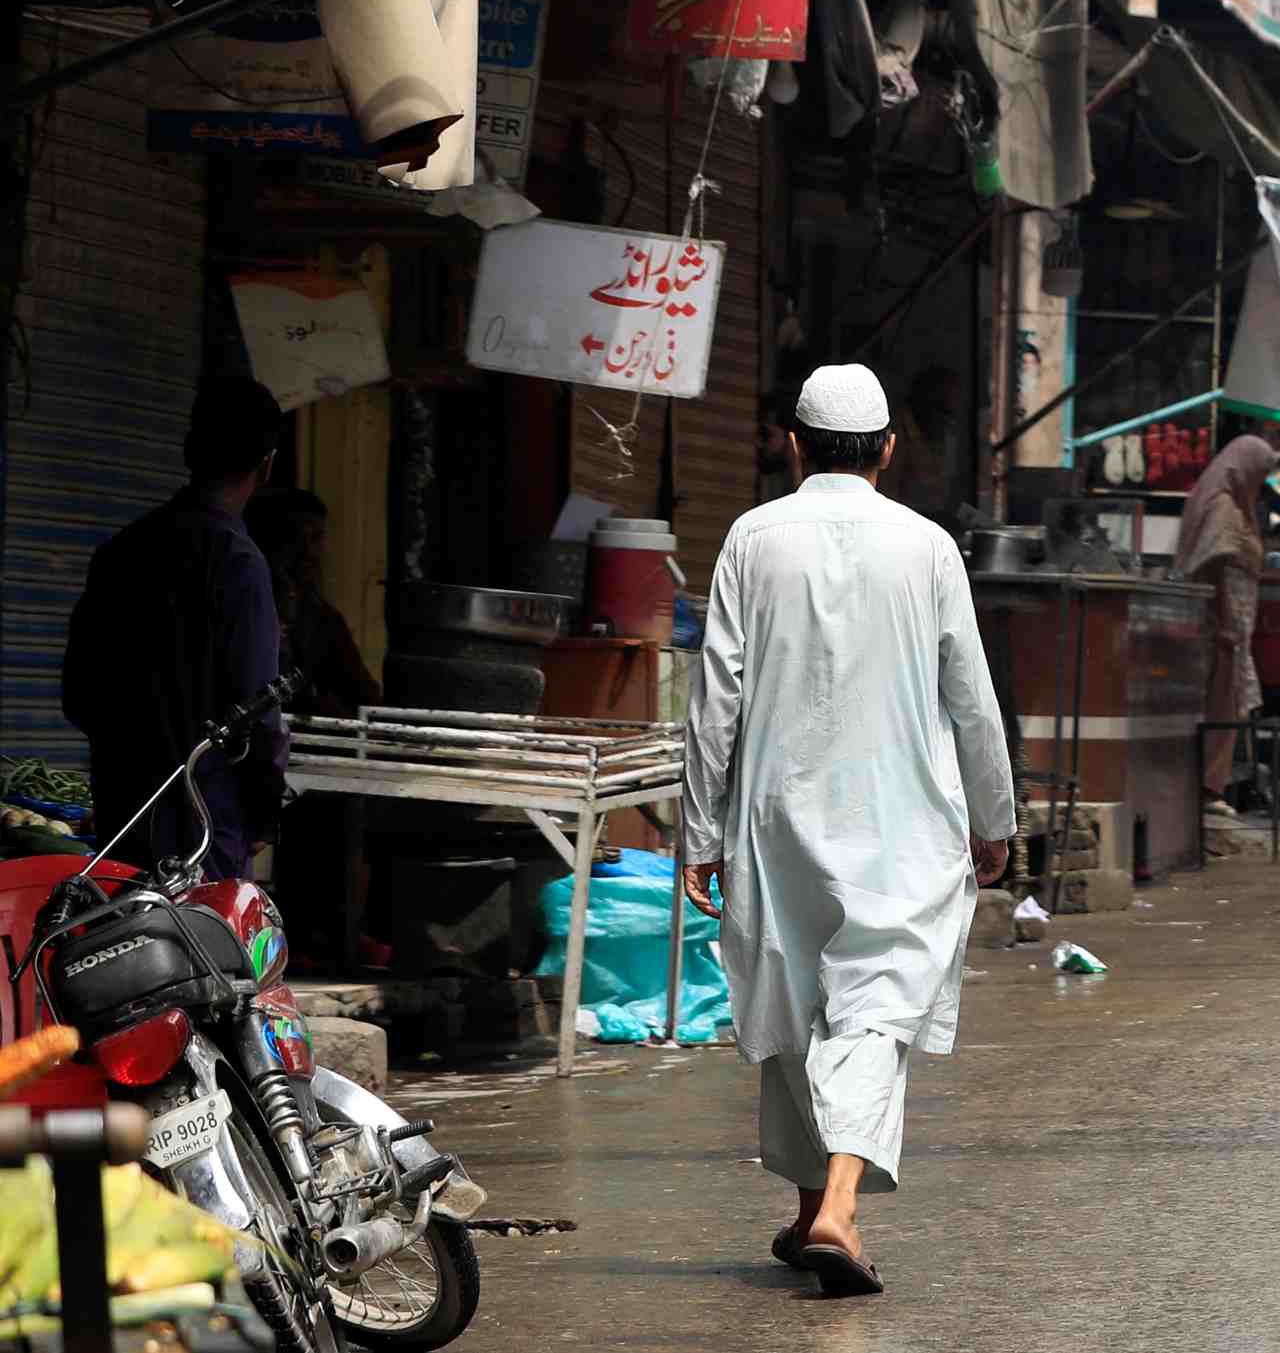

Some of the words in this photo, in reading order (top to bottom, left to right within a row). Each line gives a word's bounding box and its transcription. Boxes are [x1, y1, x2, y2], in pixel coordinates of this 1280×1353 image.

[64, 934, 157, 978] HONDA
[178, 1111, 219, 1141] 9028
[162, 1139, 201, 1163] SHEIKH
